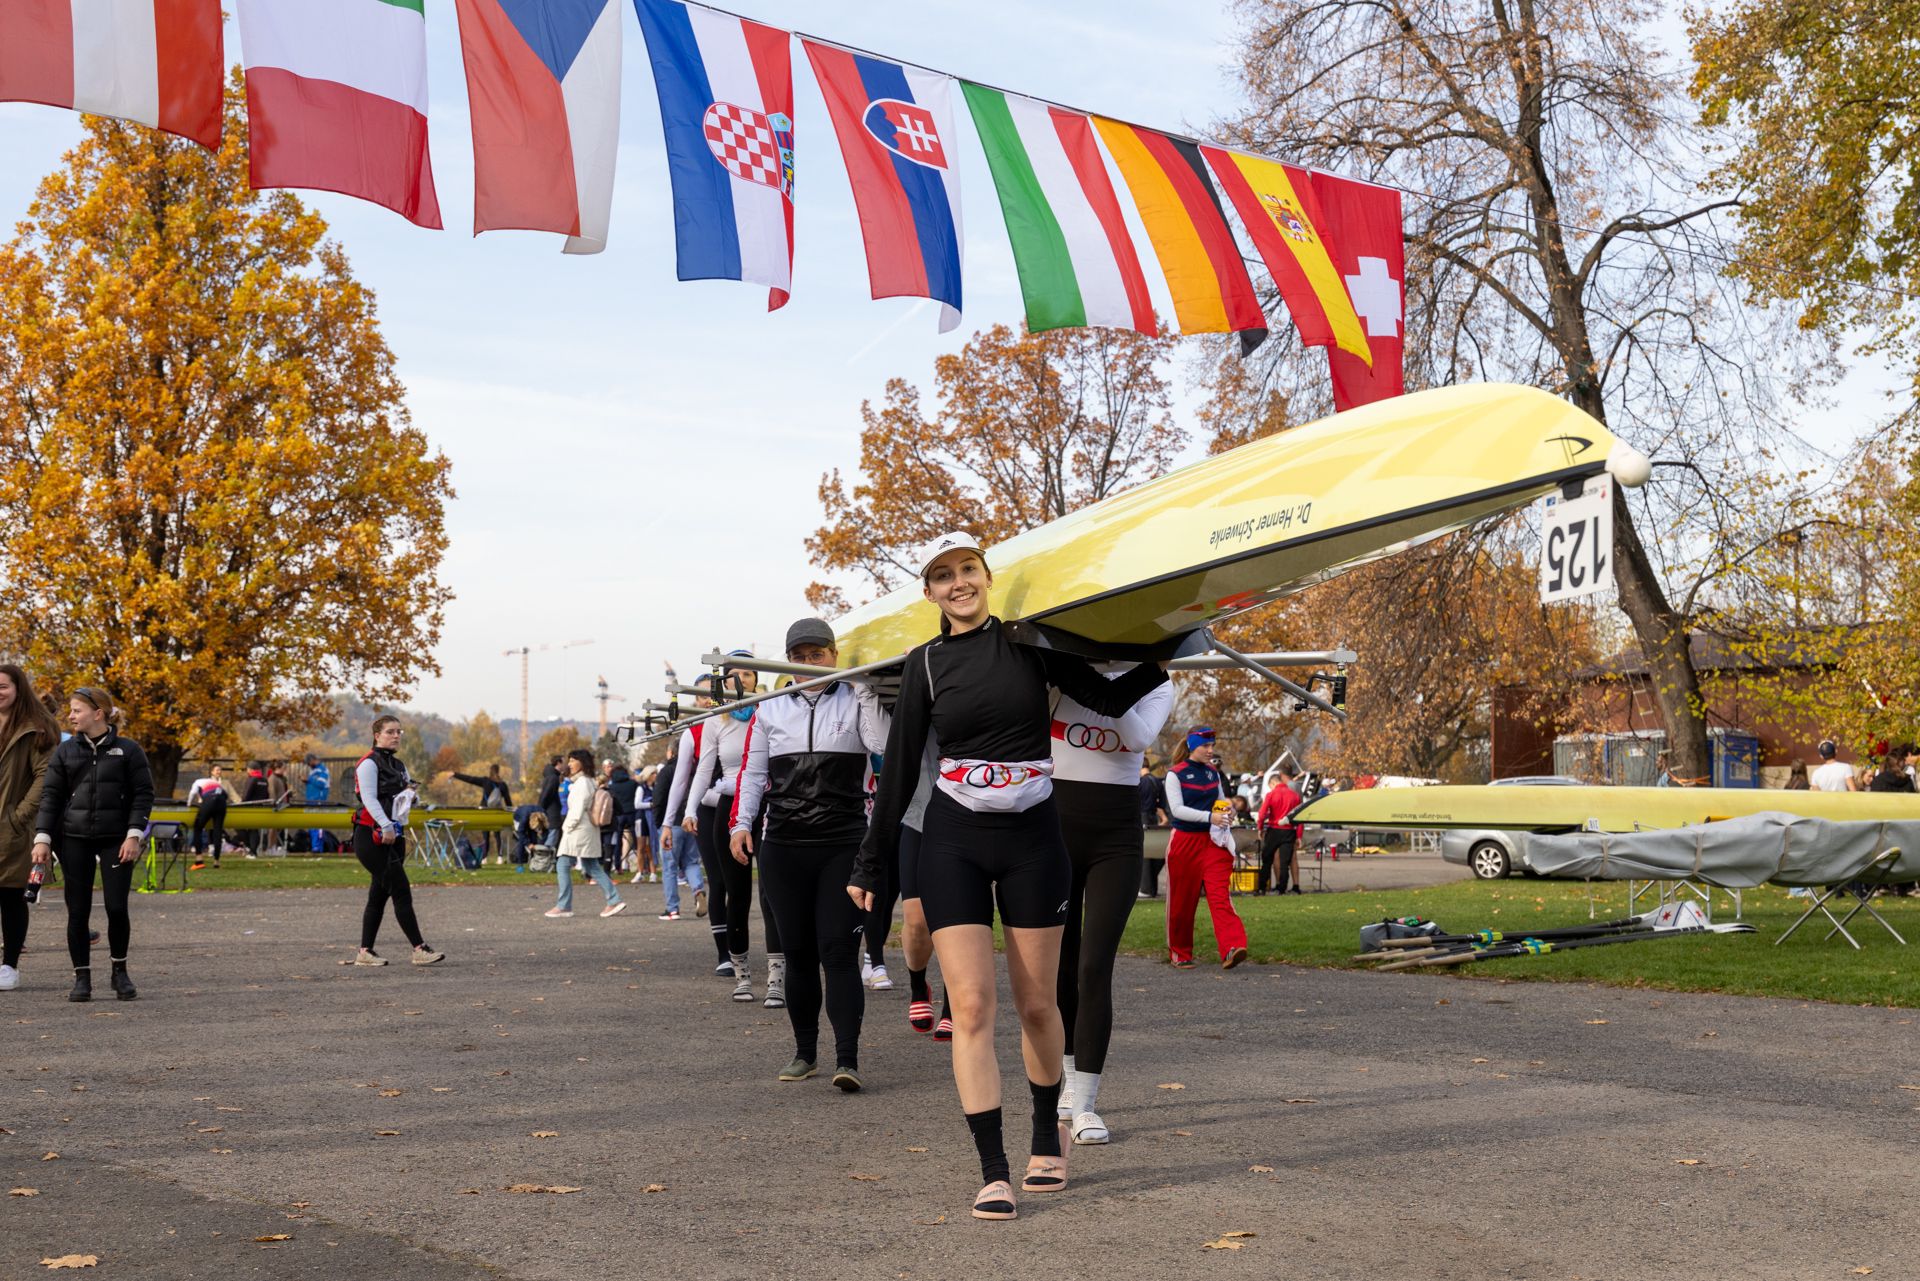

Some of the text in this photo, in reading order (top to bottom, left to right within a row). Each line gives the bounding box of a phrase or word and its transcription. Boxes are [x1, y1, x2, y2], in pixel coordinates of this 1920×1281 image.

[1210, 502, 1312, 550] Dr. Henner Schwenke
[1548, 516, 1606, 592] 125
